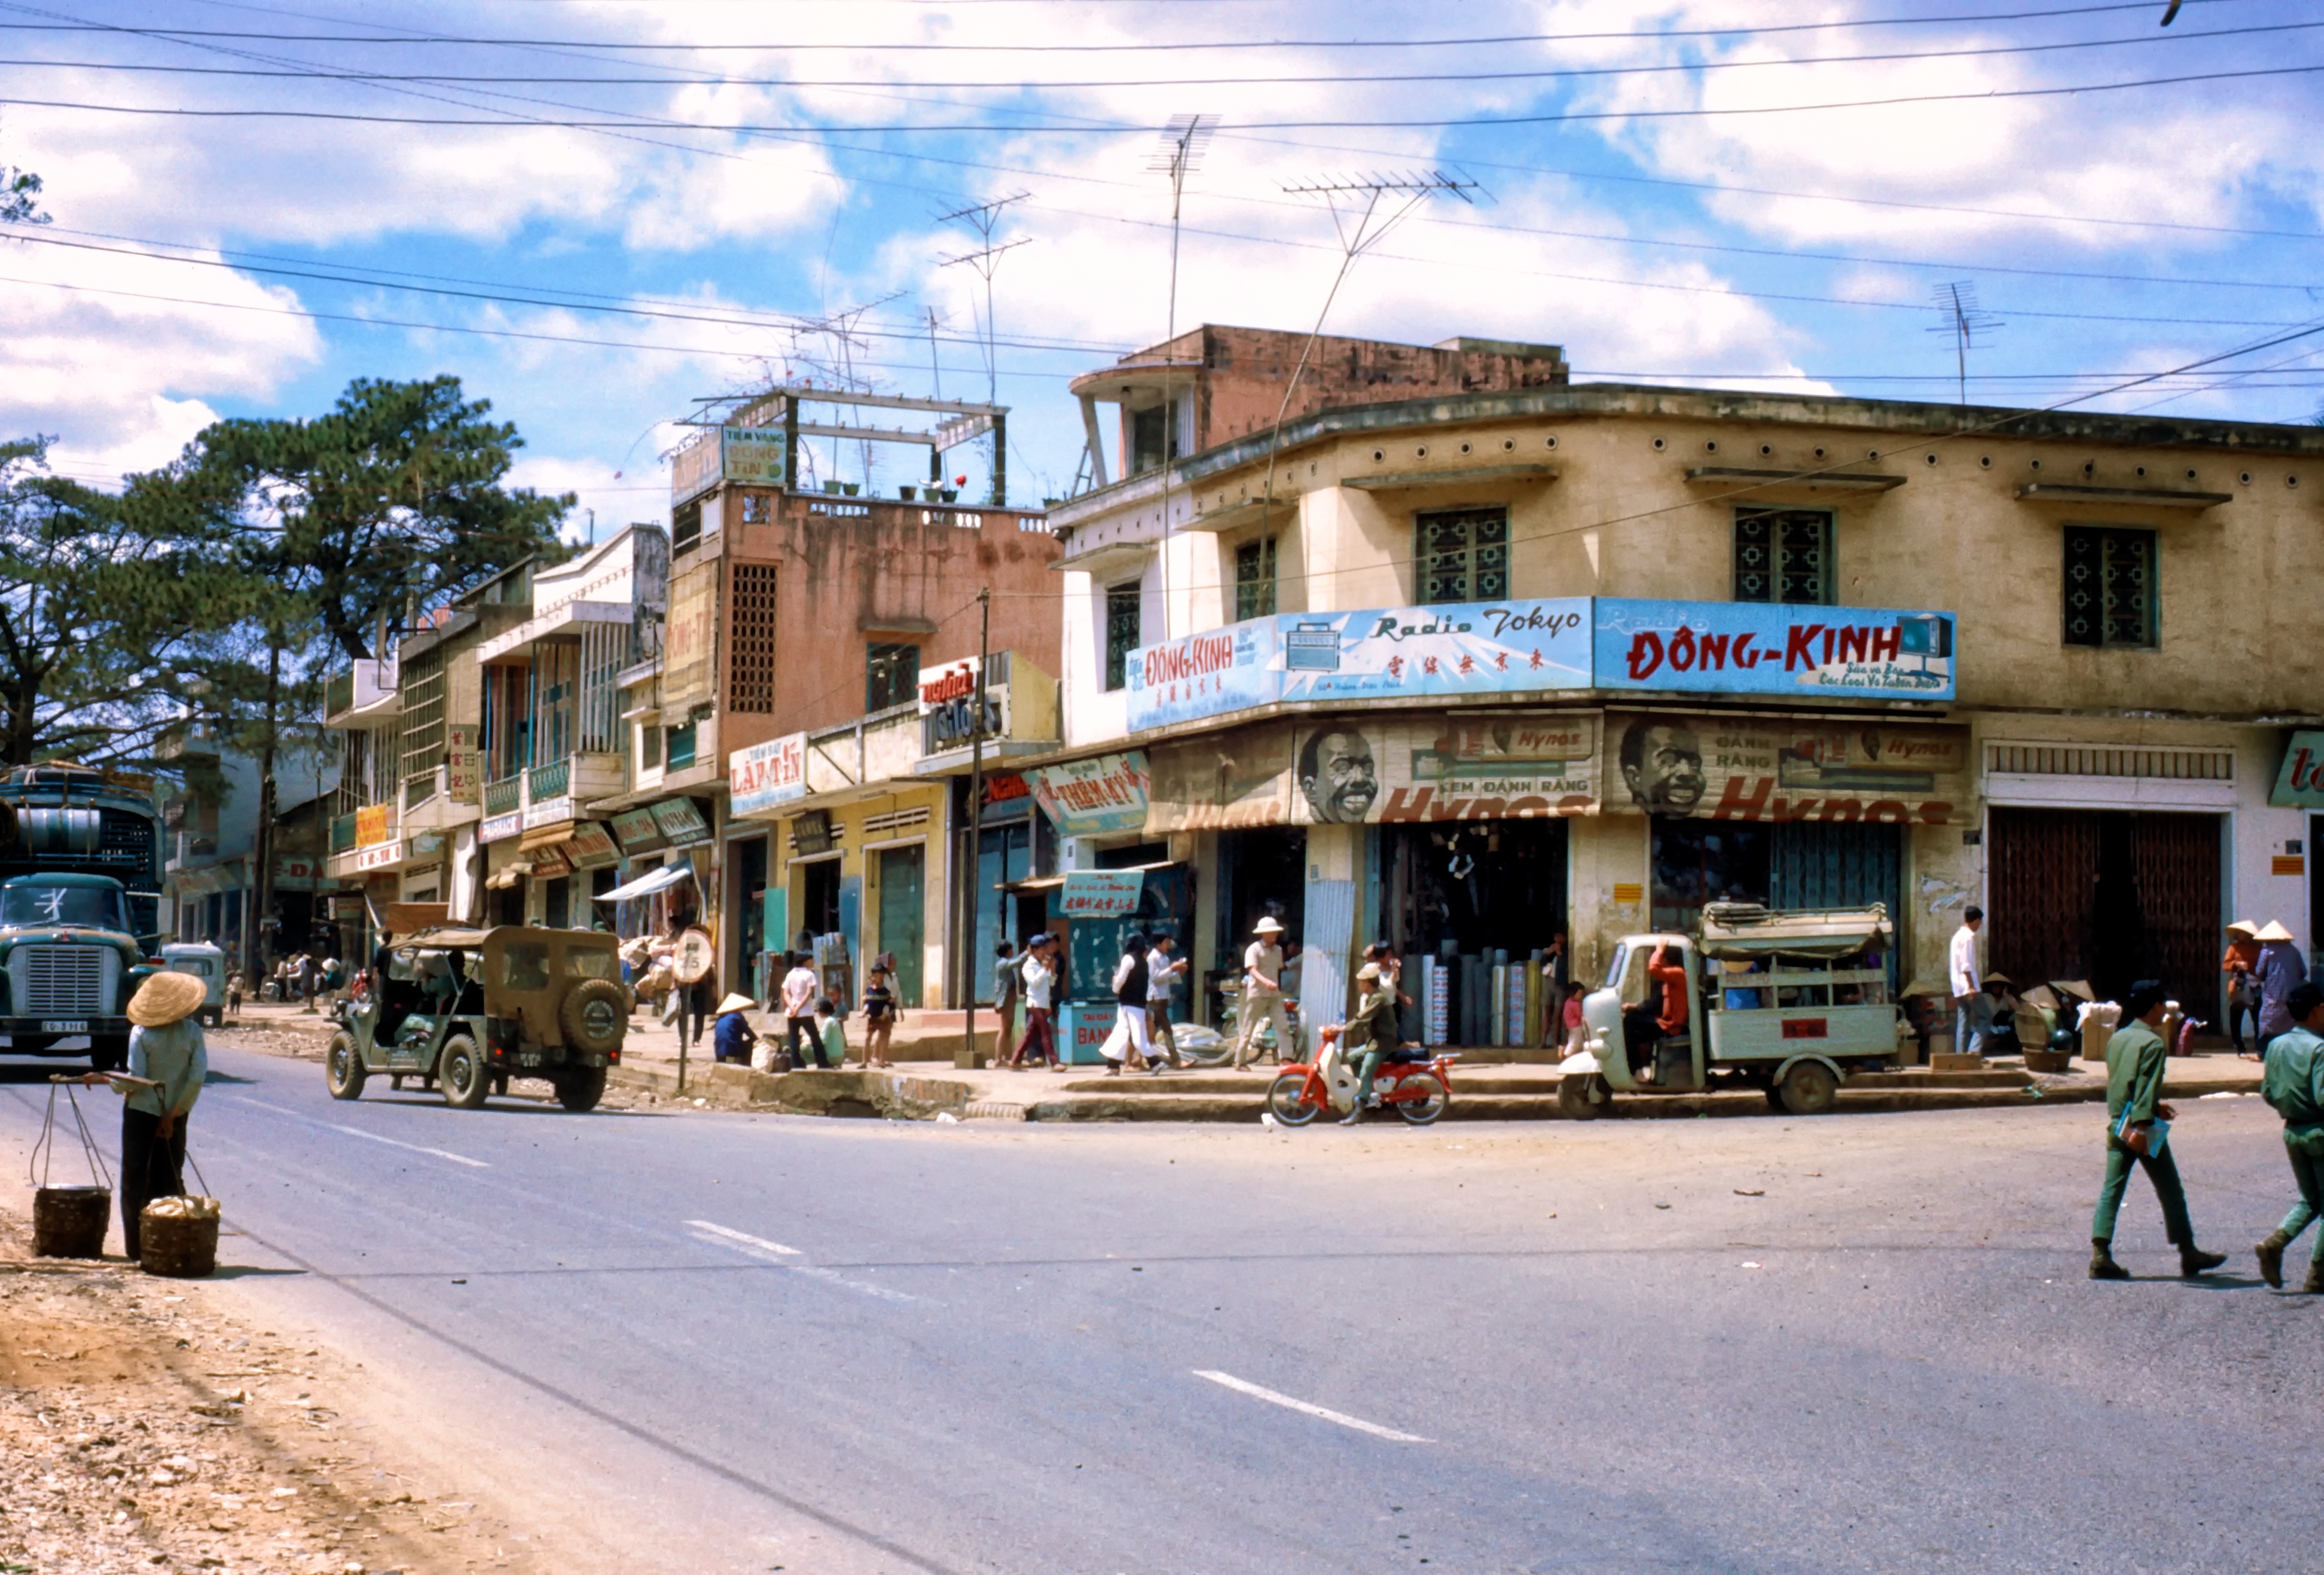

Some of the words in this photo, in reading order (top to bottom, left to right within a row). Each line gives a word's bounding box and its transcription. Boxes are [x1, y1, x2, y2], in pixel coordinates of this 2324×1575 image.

[1369, 615, 1471, 642] Radio
[1482, 606, 1582, 639] Tokyo
[1517, 731, 1582, 750] Hynos
[1888, 738, 1953, 758] Hynos
